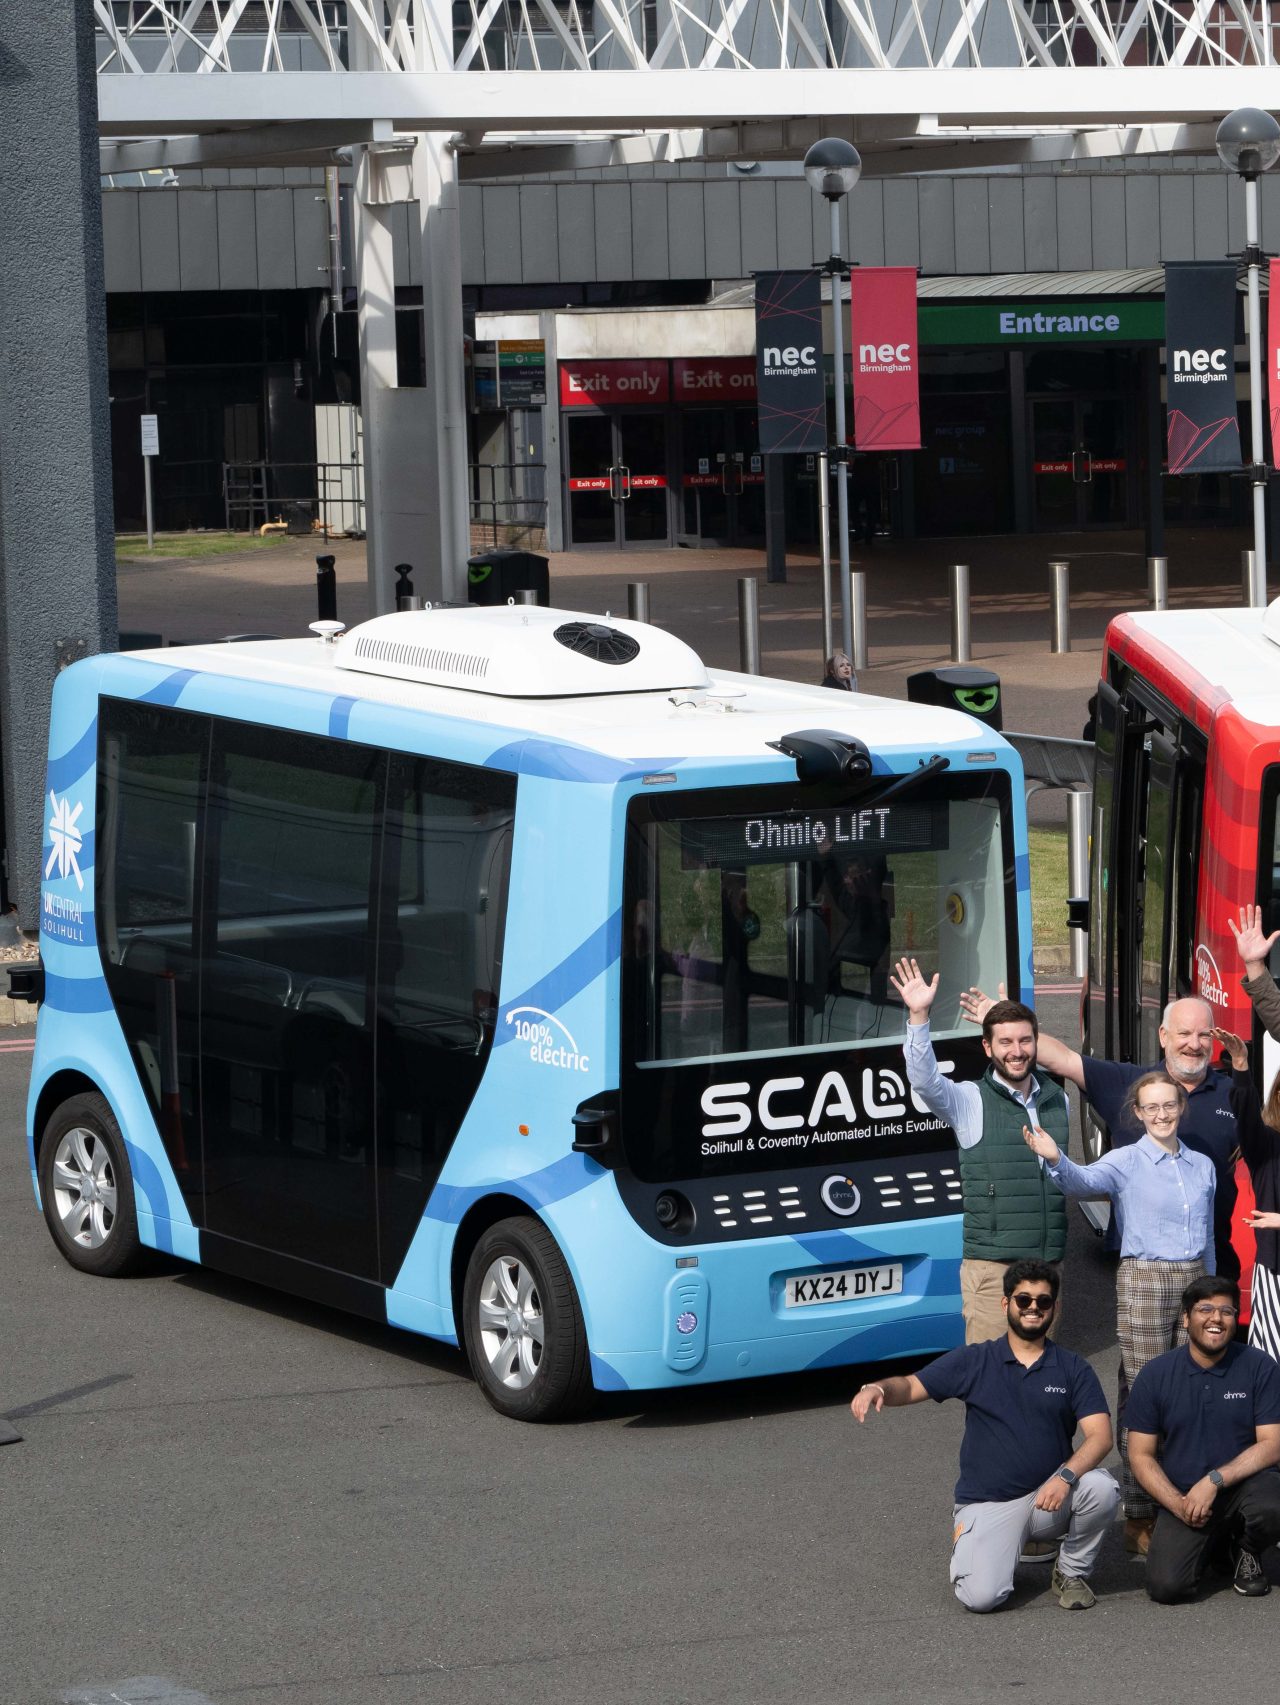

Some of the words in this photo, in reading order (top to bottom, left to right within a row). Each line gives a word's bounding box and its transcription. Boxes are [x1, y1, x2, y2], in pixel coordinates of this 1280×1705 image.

[1000, 312, 1120, 334] Entrance
[763, 346, 816, 367] nec
[859, 343, 911, 363] nec
[1173, 349, 1227, 372] nec
[682, 370, 722, 389] Exit
[729, 369, 757, 388] on
[764, 367, 817, 377] Birmingham
[860, 364, 911, 374] Birmingham
[1174, 373, 1227, 384] Birmingham
[569, 373, 610, 392] Exit
[617, 371, 660, 395] only
[592, 480, 606, 488] only
[644, 478, 658, 486] only
[705, 475, 719, 484] only
[745, 817, 827, 848] Ohmio
[835, 808, 890, 842] LIFT
[44, 918, 84, 942] SOLIHULL
[1201, 982, 1229, 1008] electric
[515, 1019, 553, 1047] 100%
[530, 1041, 589, 1072] electric
[701, 1139, 743, 1155] Solihull
[746, 1137, 755, 1150] &
[758, 1134, 809, 1150] Coventry
[812, 1127, 871, 1144] Automated
[874, 1123, 903, 1137] Links
[906, 1118, 950, 1133] Evolutio
[794, 1274, 848, 1303] KX24
[854, 1268, 894, 1295] DYJ
